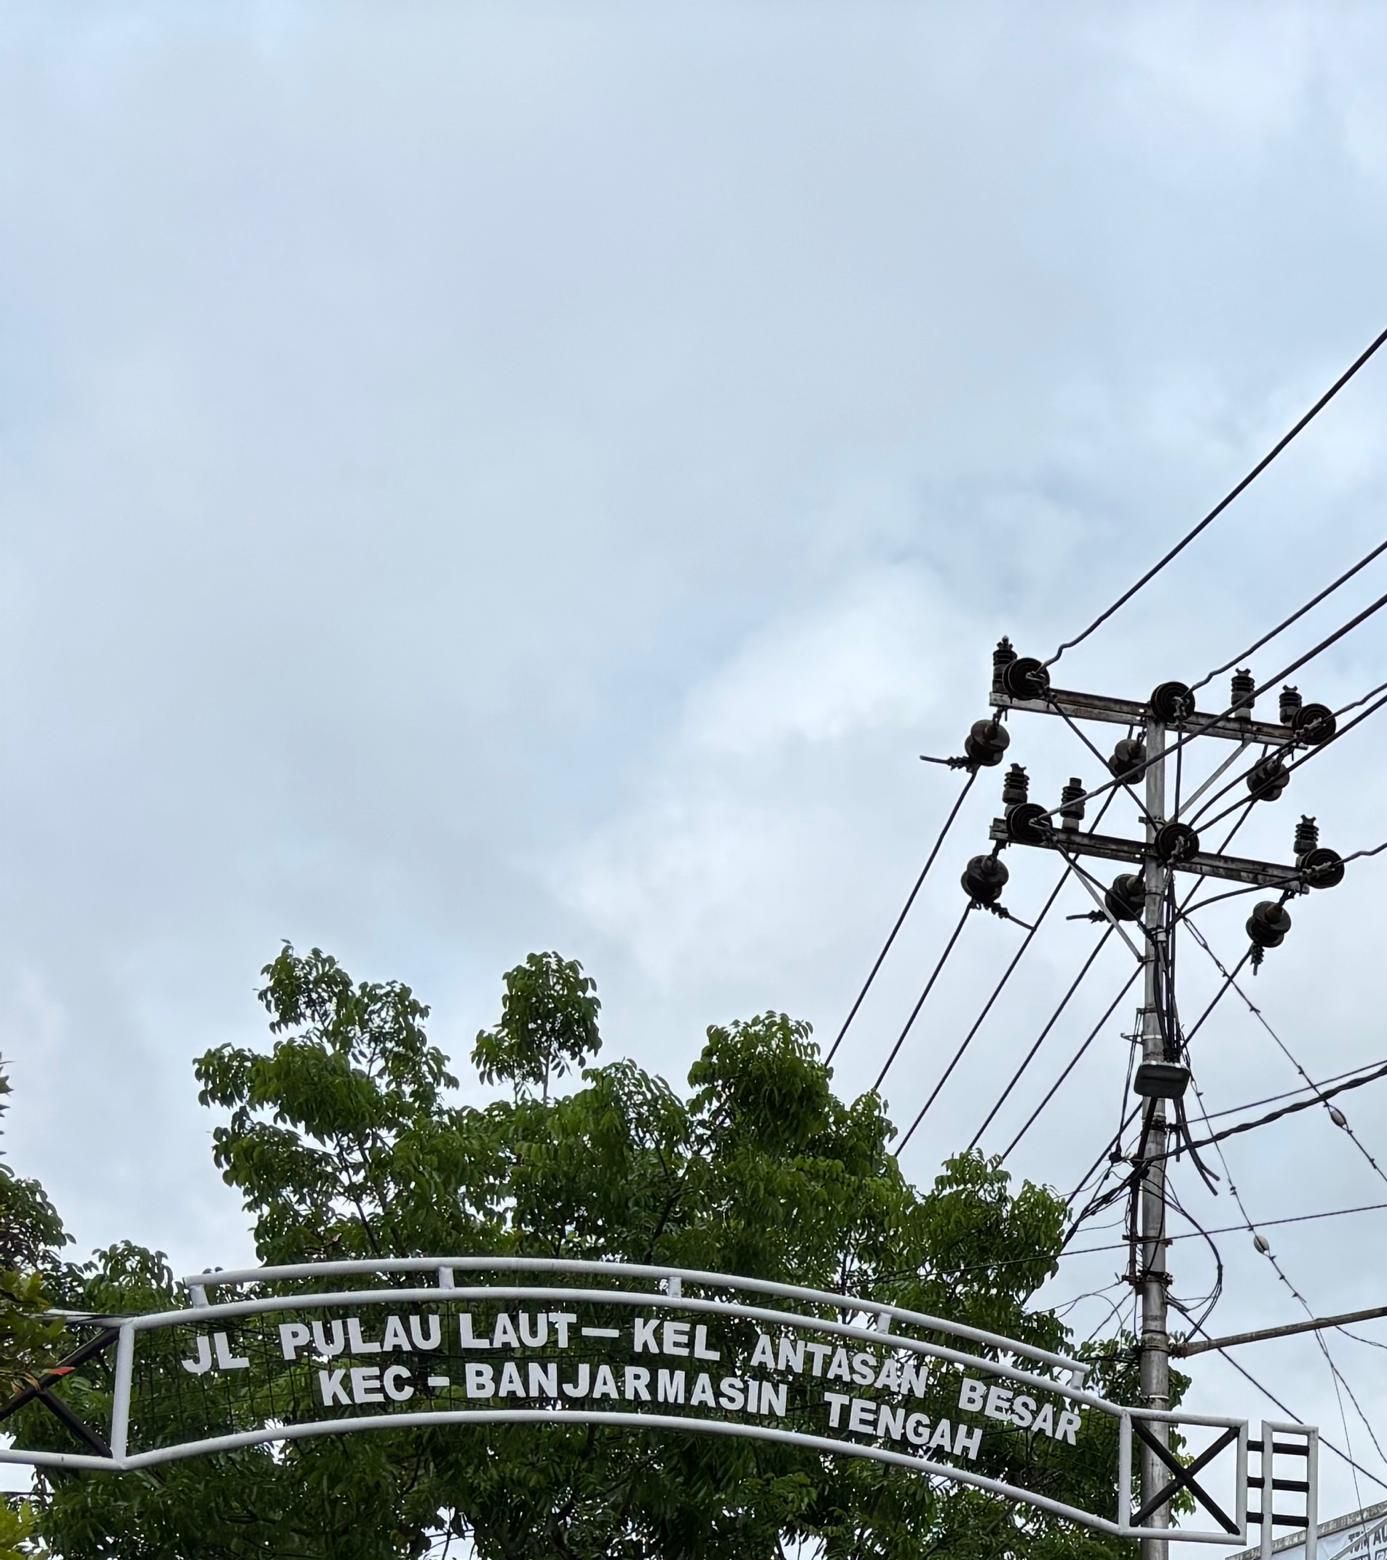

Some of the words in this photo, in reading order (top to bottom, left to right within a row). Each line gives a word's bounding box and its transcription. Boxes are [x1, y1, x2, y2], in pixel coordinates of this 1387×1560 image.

[181, 1331, 250, 1374] JL
[278, 1314, 442, 1362] PULAU
[459, 1312, 577, 1351] LAUT
[633, 1316, 721, 1361] KEL
[750, 1333, 928, 1399] ANTASAN
[958, 1378, 1082, 1446] BESAR
[318, 1365, 414, 1407] KEC
[464, 1362, 787, 1417] BANJARMASIN
[823, 1391, 983, 1461] TENGAH
